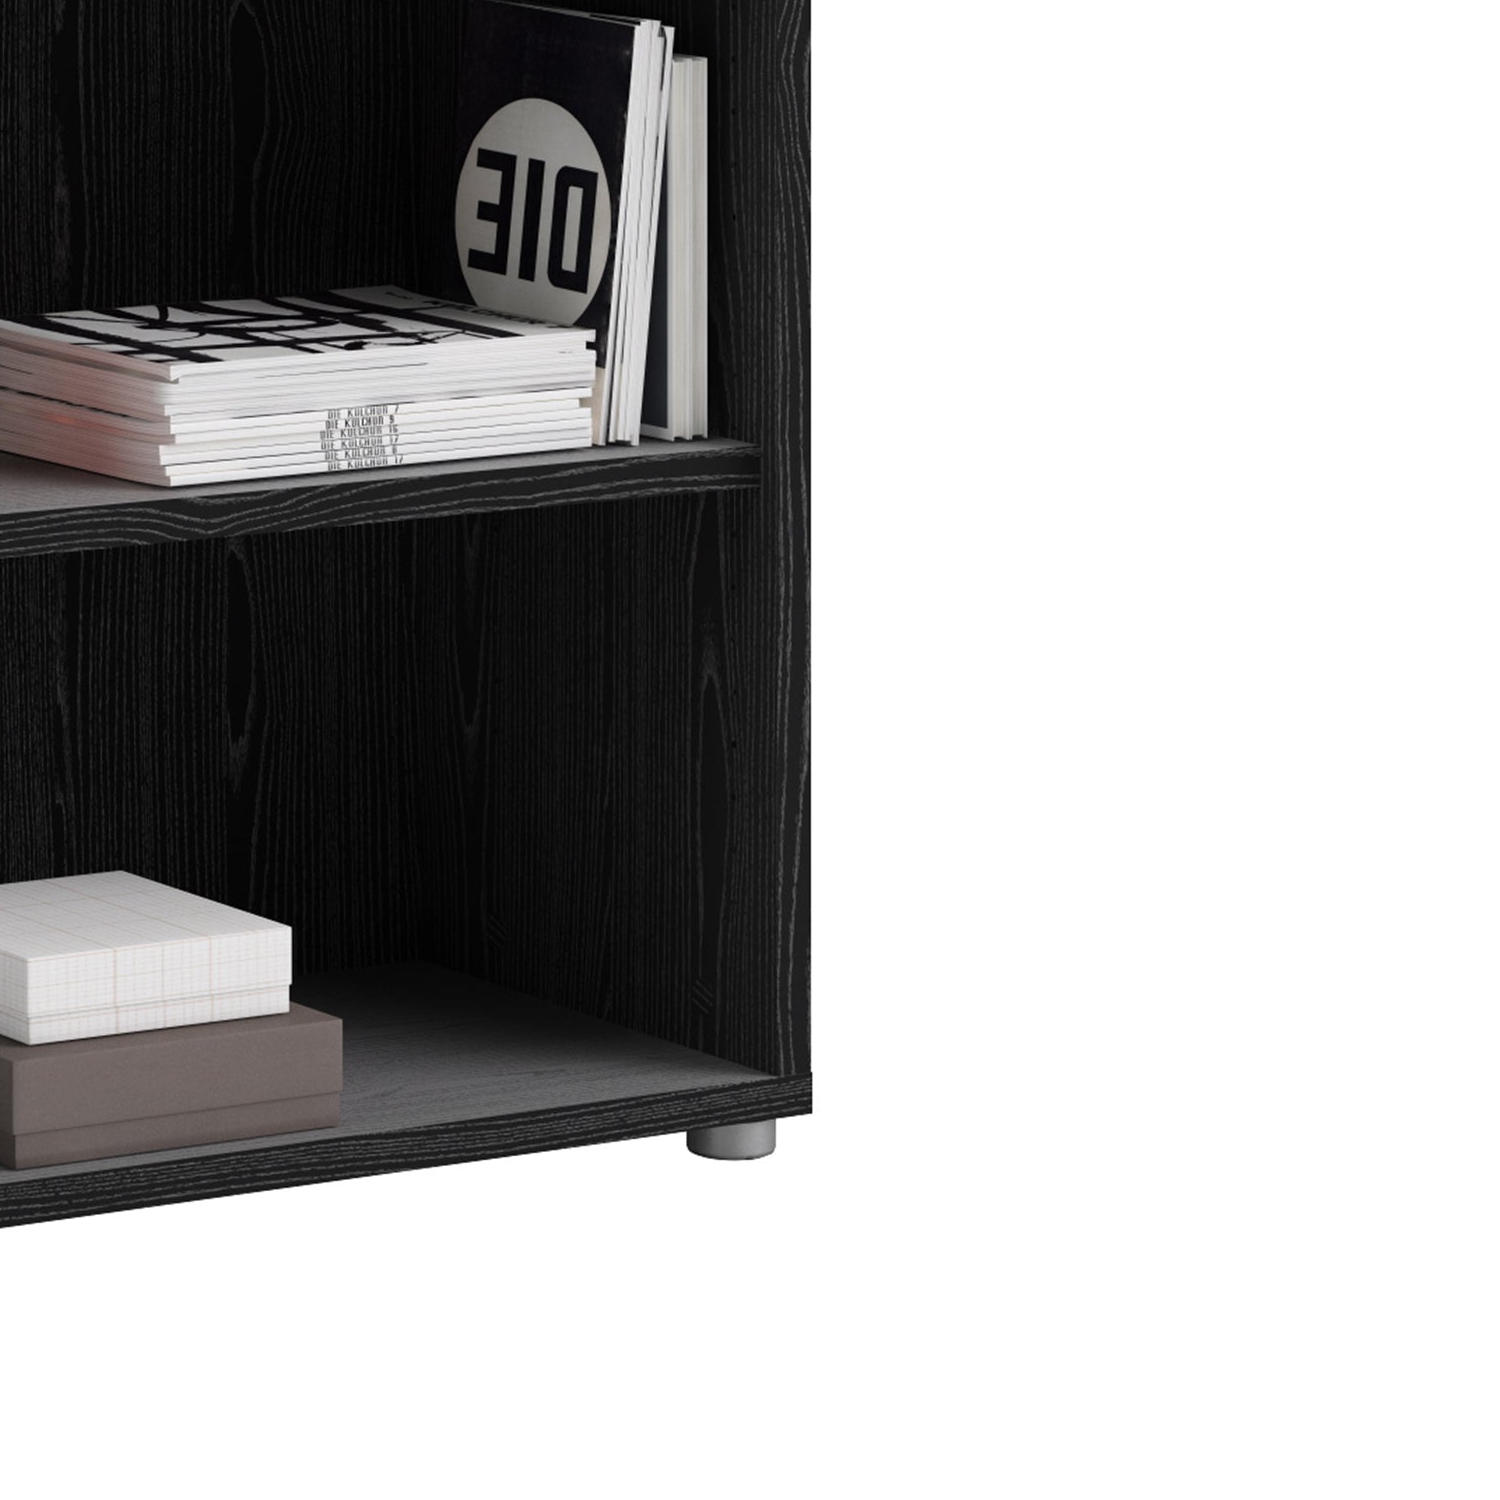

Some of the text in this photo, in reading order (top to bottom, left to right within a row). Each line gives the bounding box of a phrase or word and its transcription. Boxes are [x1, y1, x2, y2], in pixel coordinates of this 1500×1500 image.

[328, 409, 340, 419] DIE
[325, 420, 338, 429] DIE
[320, 430, 333, 439] DIE
[321, 440, 333, 450] DIE
[325, 451, 338, 460] DIE
[328, 461, 340, 471] DIE
